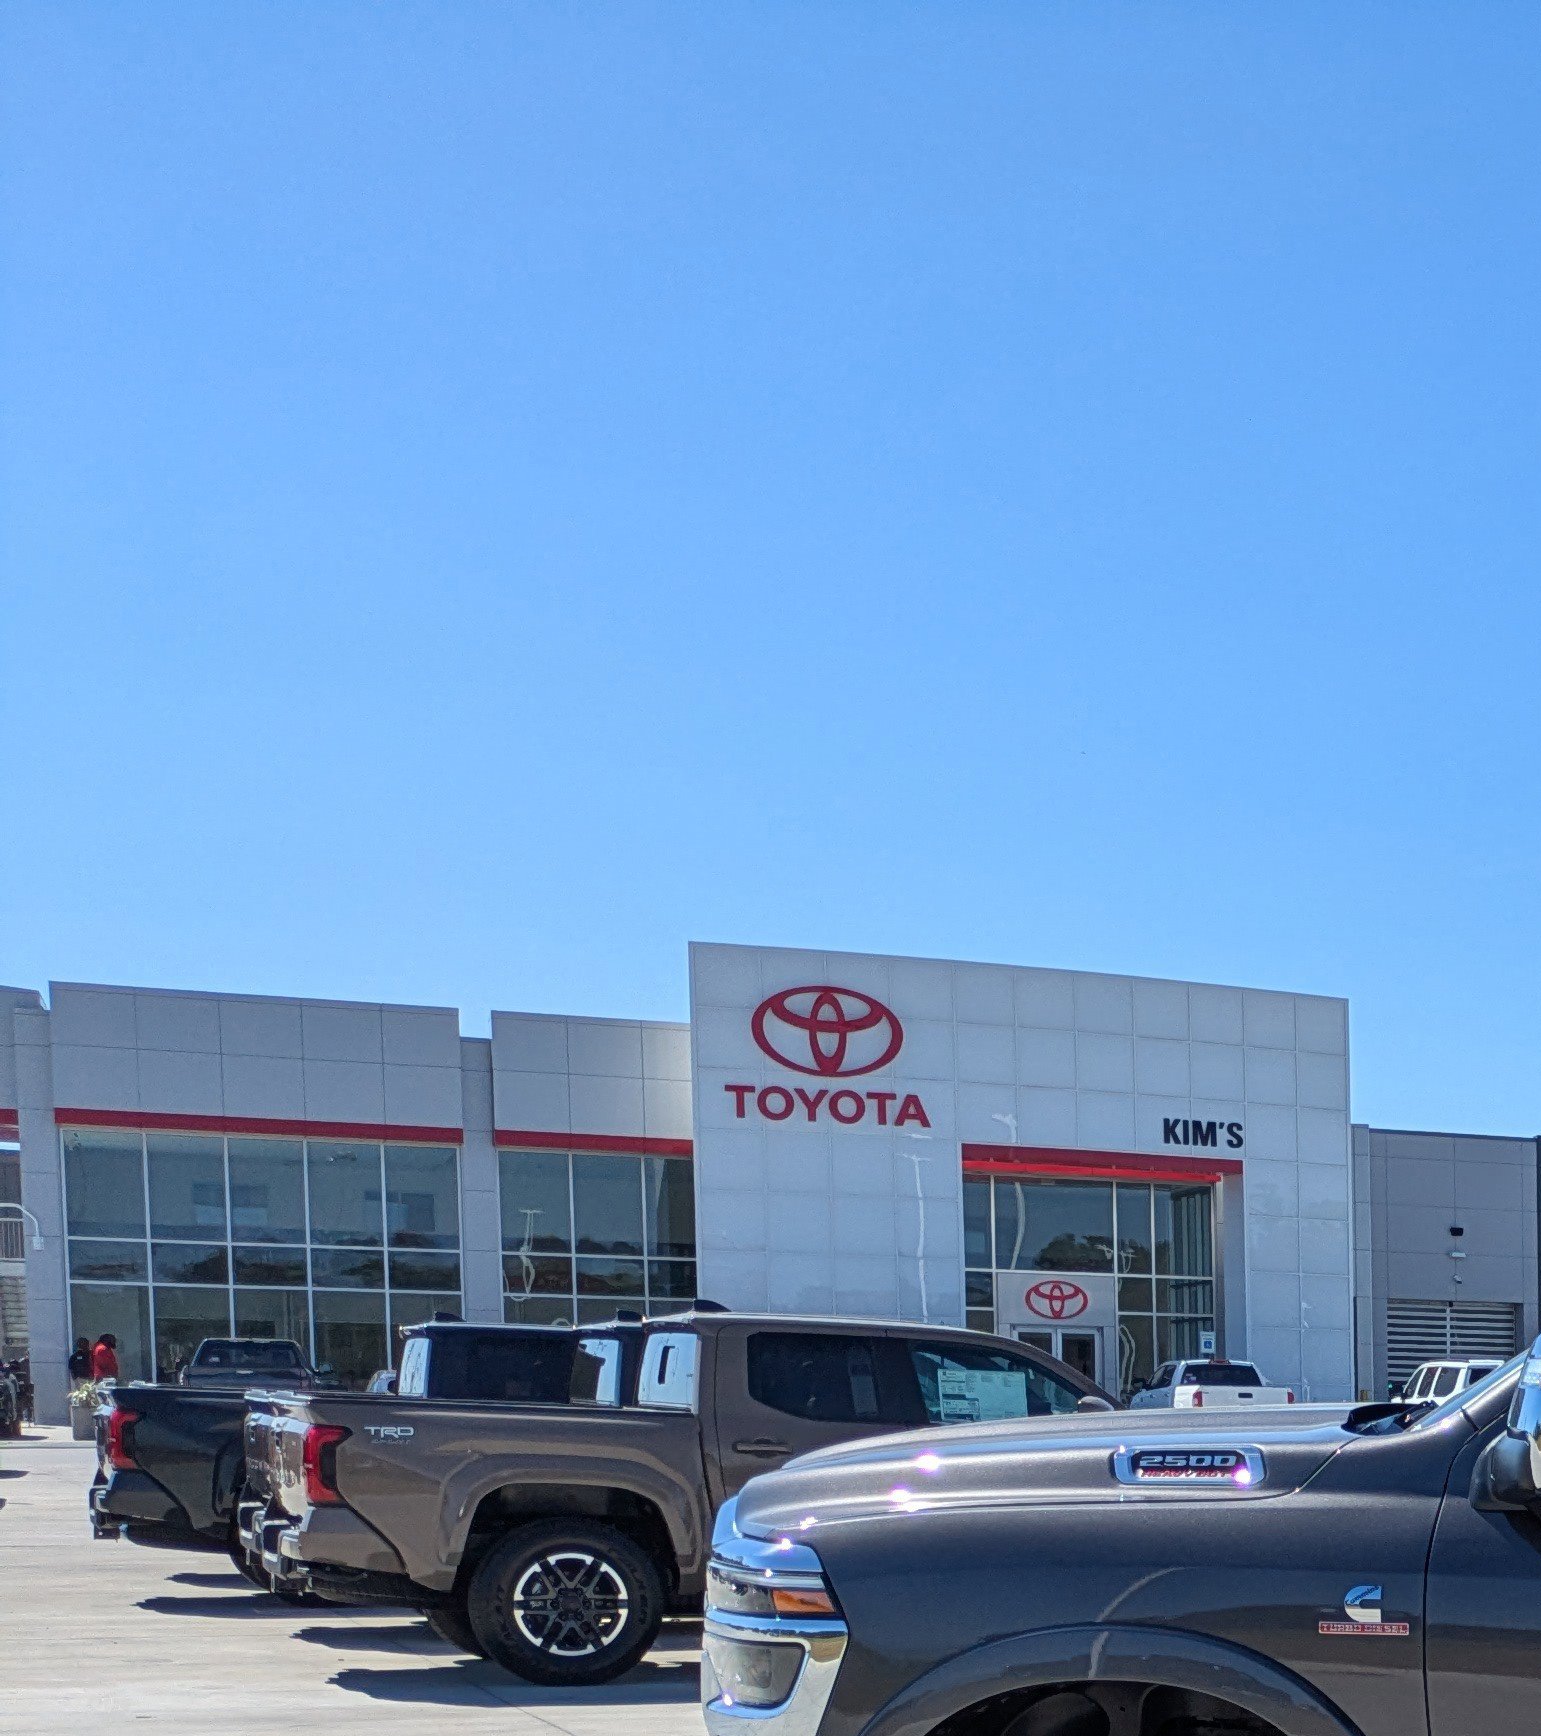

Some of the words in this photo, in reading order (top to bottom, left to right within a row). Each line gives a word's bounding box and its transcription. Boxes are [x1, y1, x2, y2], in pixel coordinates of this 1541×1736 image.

[724, 1084, 931, 1128] TOYOTA
[1163, 1118, 1244, 1149] KIM'S
[364, 1426, 414, 1438] TRD
[1139, 1455, 1237, 1467] 2500
[1322, 1623, 1361, 1633] TURBO
